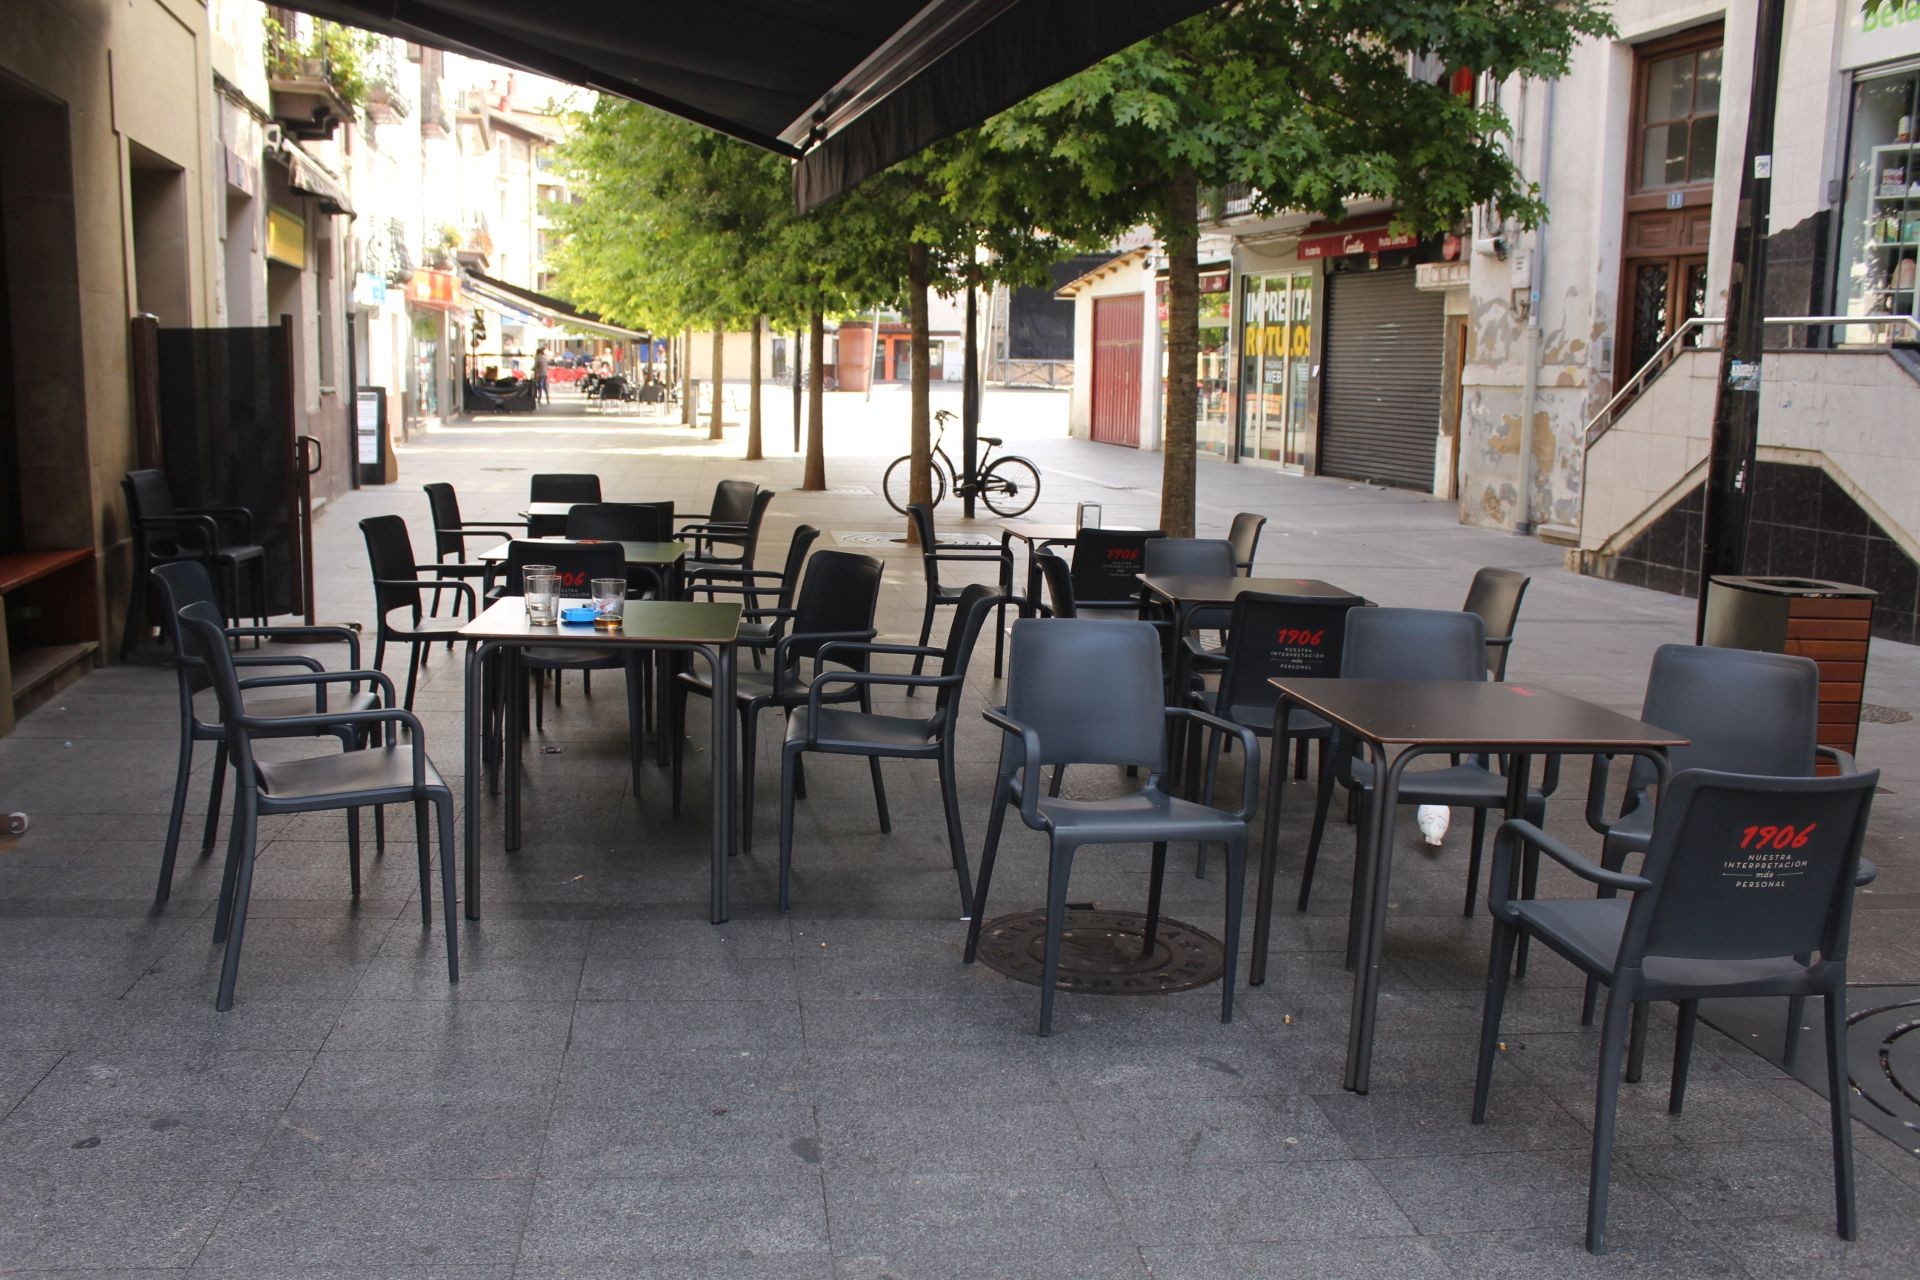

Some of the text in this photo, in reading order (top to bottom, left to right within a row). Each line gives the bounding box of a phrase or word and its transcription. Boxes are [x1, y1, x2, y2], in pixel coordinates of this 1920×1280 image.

[1265, 370, 1282, 383] WEB
[1106, 548, 1140, 560] 1906
[1278, 629, 1324, 646] 1906
[1740, 822, 1817, 849] 1906
[1736, 880, 1785, 888] PERSONAL
